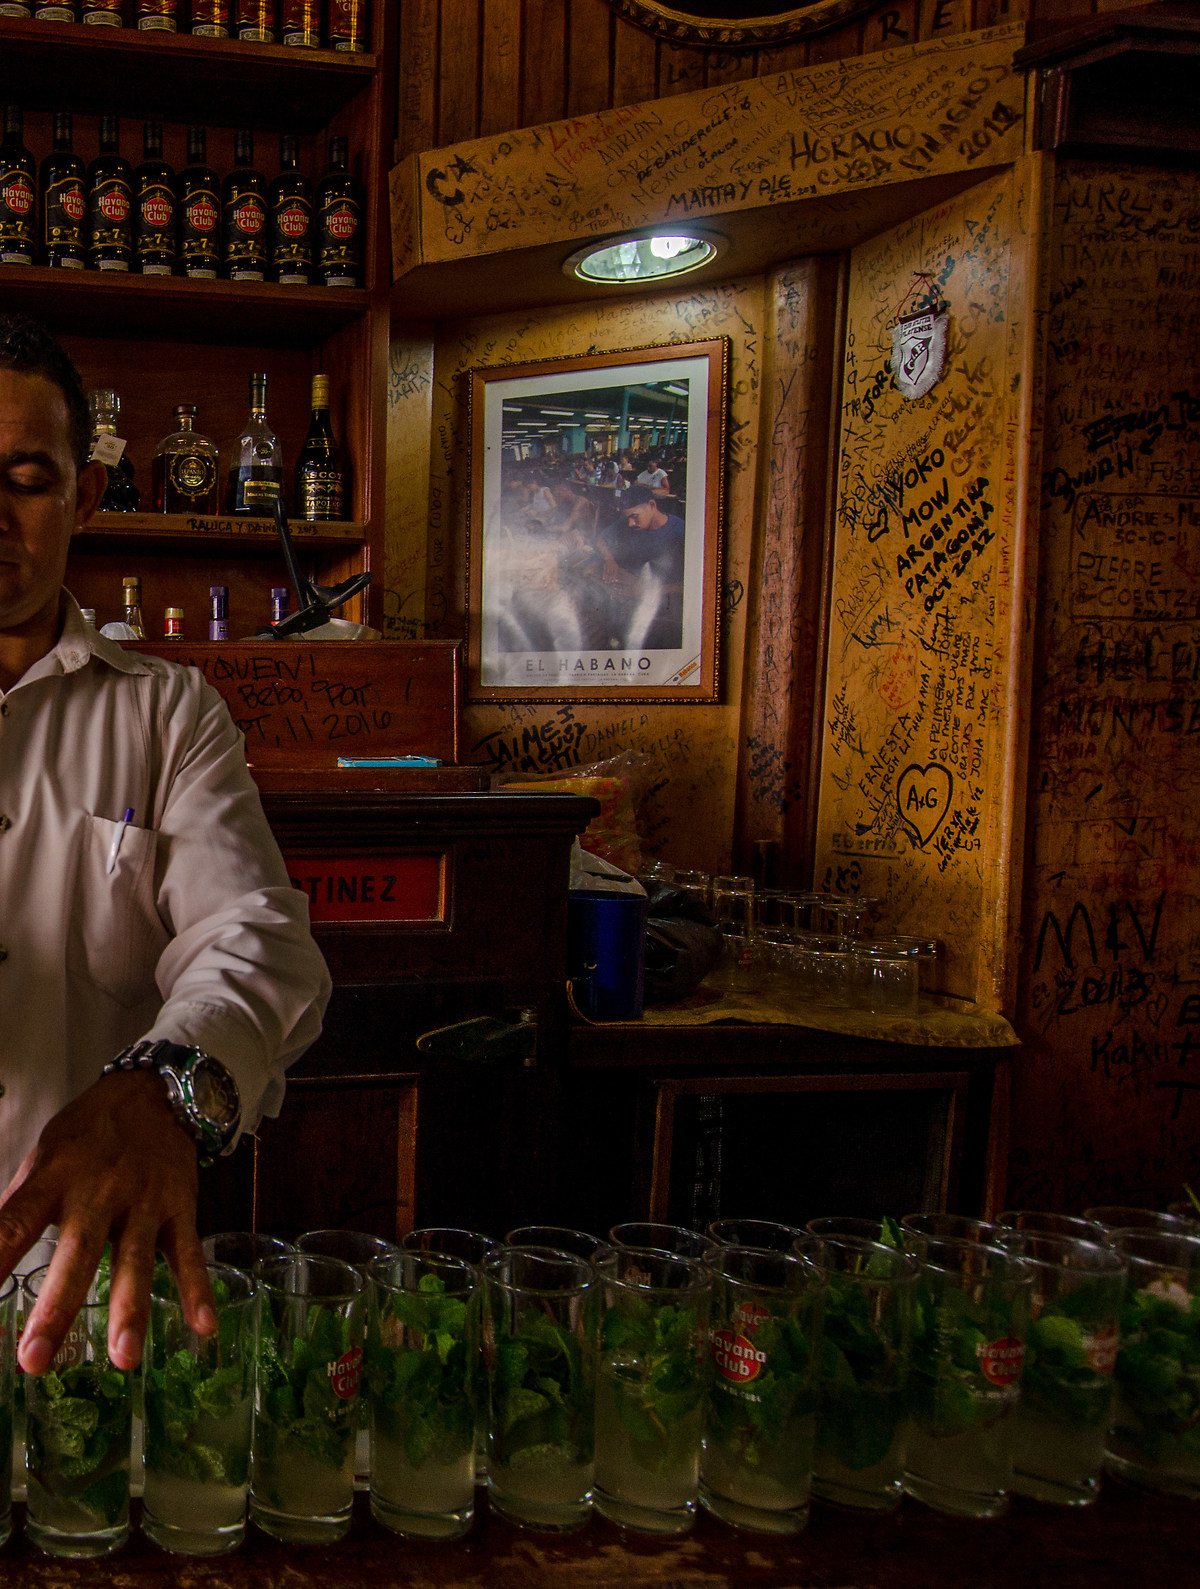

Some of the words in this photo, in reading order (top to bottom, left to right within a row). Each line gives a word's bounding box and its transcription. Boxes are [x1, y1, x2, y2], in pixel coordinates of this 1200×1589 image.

[597, 111, 663, 165] ADRIAN
[790, 122, 915, 172] HORACIO
[759, 174, 792, 197] ALE
[2, 187, 34, 200] Havana
[9, 198, 30, 209] Club
[59, 193, 87, 207] Havana
[98, 196, 130, 209] Havana
[66, 204, 84, 216] Club
[105, 205, 125, 216] Club
[141, 203, 173, 214] Havana
[186, 207, 218, 218] Havana
[147, 211, 167, 222] Club
[233, 210, 265, 221] Havana
[277, 214, 310, 225] Havana
[16, 221, 23, 231] 7
[193, 216, 213, 227] Club
[240, 218, 260, 229] Club
[284, 222, 304, 232] Club
[326, 216, 358, 227] Havana
[72, 227, 79, 237] 7
[112, 229, 119, 239] 7
[332, 224, 353, 234] Club
[154, 234, 162, 244] 7
[200, 238, 208, 248] 7
[247, 240, 255, 250] 7
[291, 243, 298, 254] 7
[340, 246, 347, 256] 7
[886, 448, 944, 508] YOKO
[902, 477, 949, 538] MOW
[1081, 499, 1175, 530] ANDRIES
[897, 477, 989, 577] ARGENTINA
[1077, 551, 1163, 587] PIERRE
[526, 659, 545, 671] EL
[559, 657, 651, 671] HABANO
[287, 714, 313, 742] 11
[323, 710, 392, 740] 2016
[858, 712, 911, 798] ERNESTA
[708, 1327, 767, 1364] Havana
[715, 1351, 751, 1376] Club
